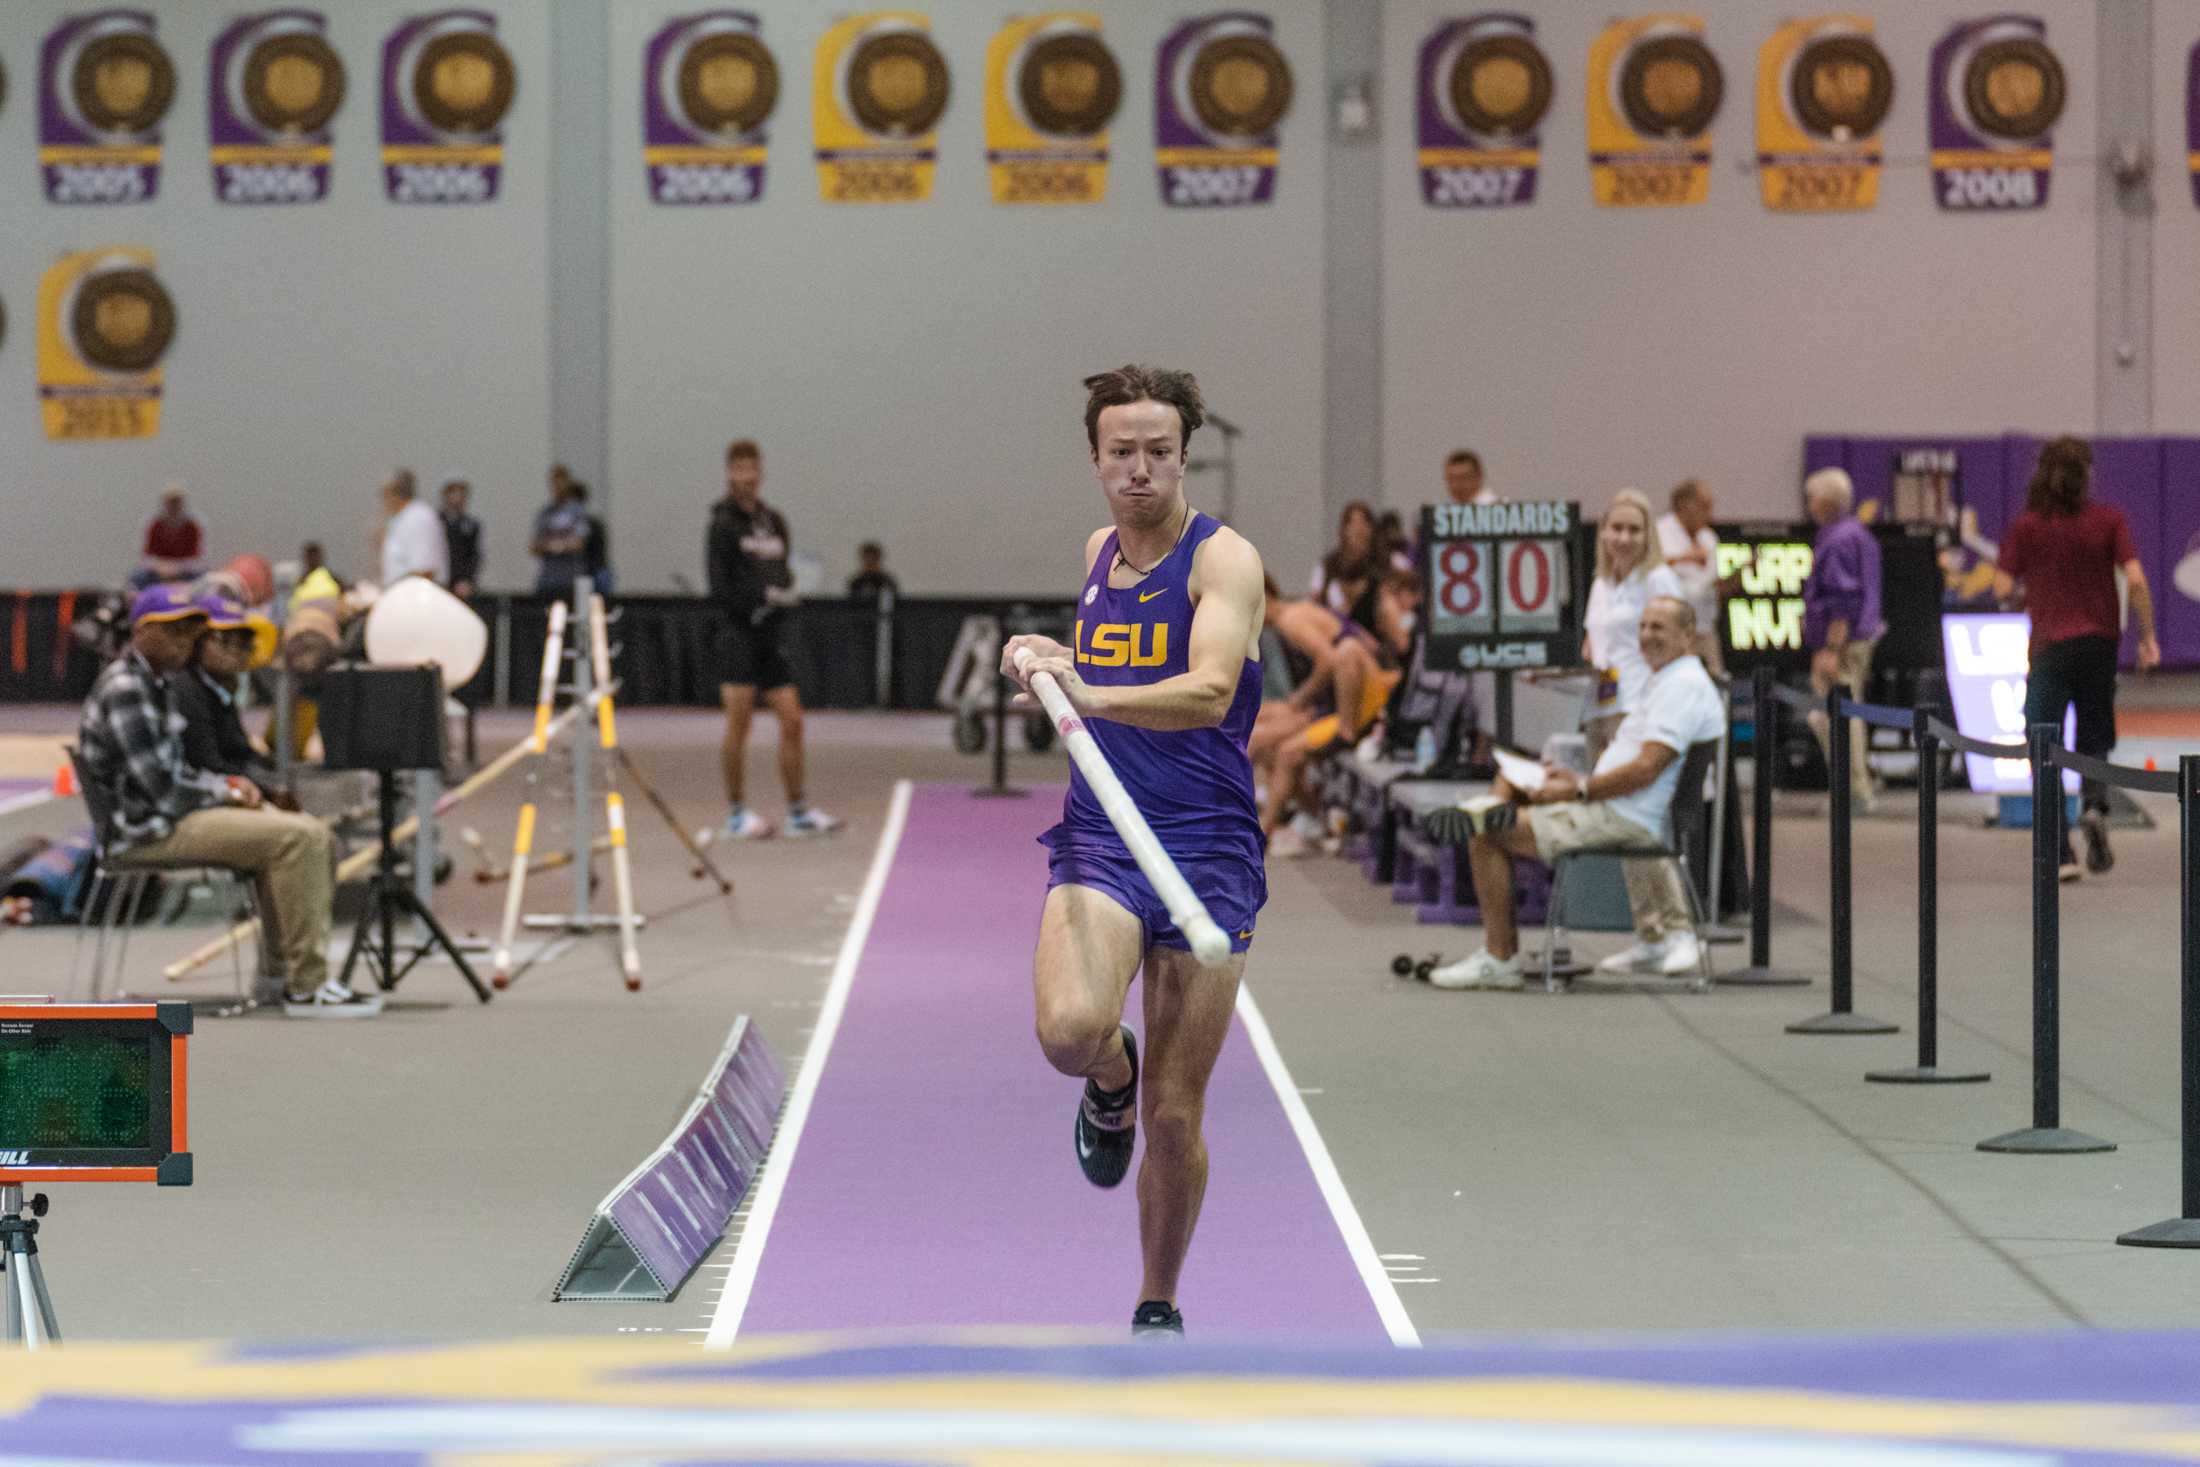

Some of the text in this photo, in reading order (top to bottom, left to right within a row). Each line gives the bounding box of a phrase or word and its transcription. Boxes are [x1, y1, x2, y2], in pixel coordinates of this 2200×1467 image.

[1171, 167, 1261, 203] 2007
[1434, 168, 1522, 203] 2007
[1611, 168, 1693, 204] 2007
[1781, 169, 1863, 206] 2007
[1946, 169, 2035, 205] 2008
[1434, 503, 1569, 536] STANDARDS
[1075, 619, 1168, 668] LSU
[0, 1151, 29, 1165] ILL
